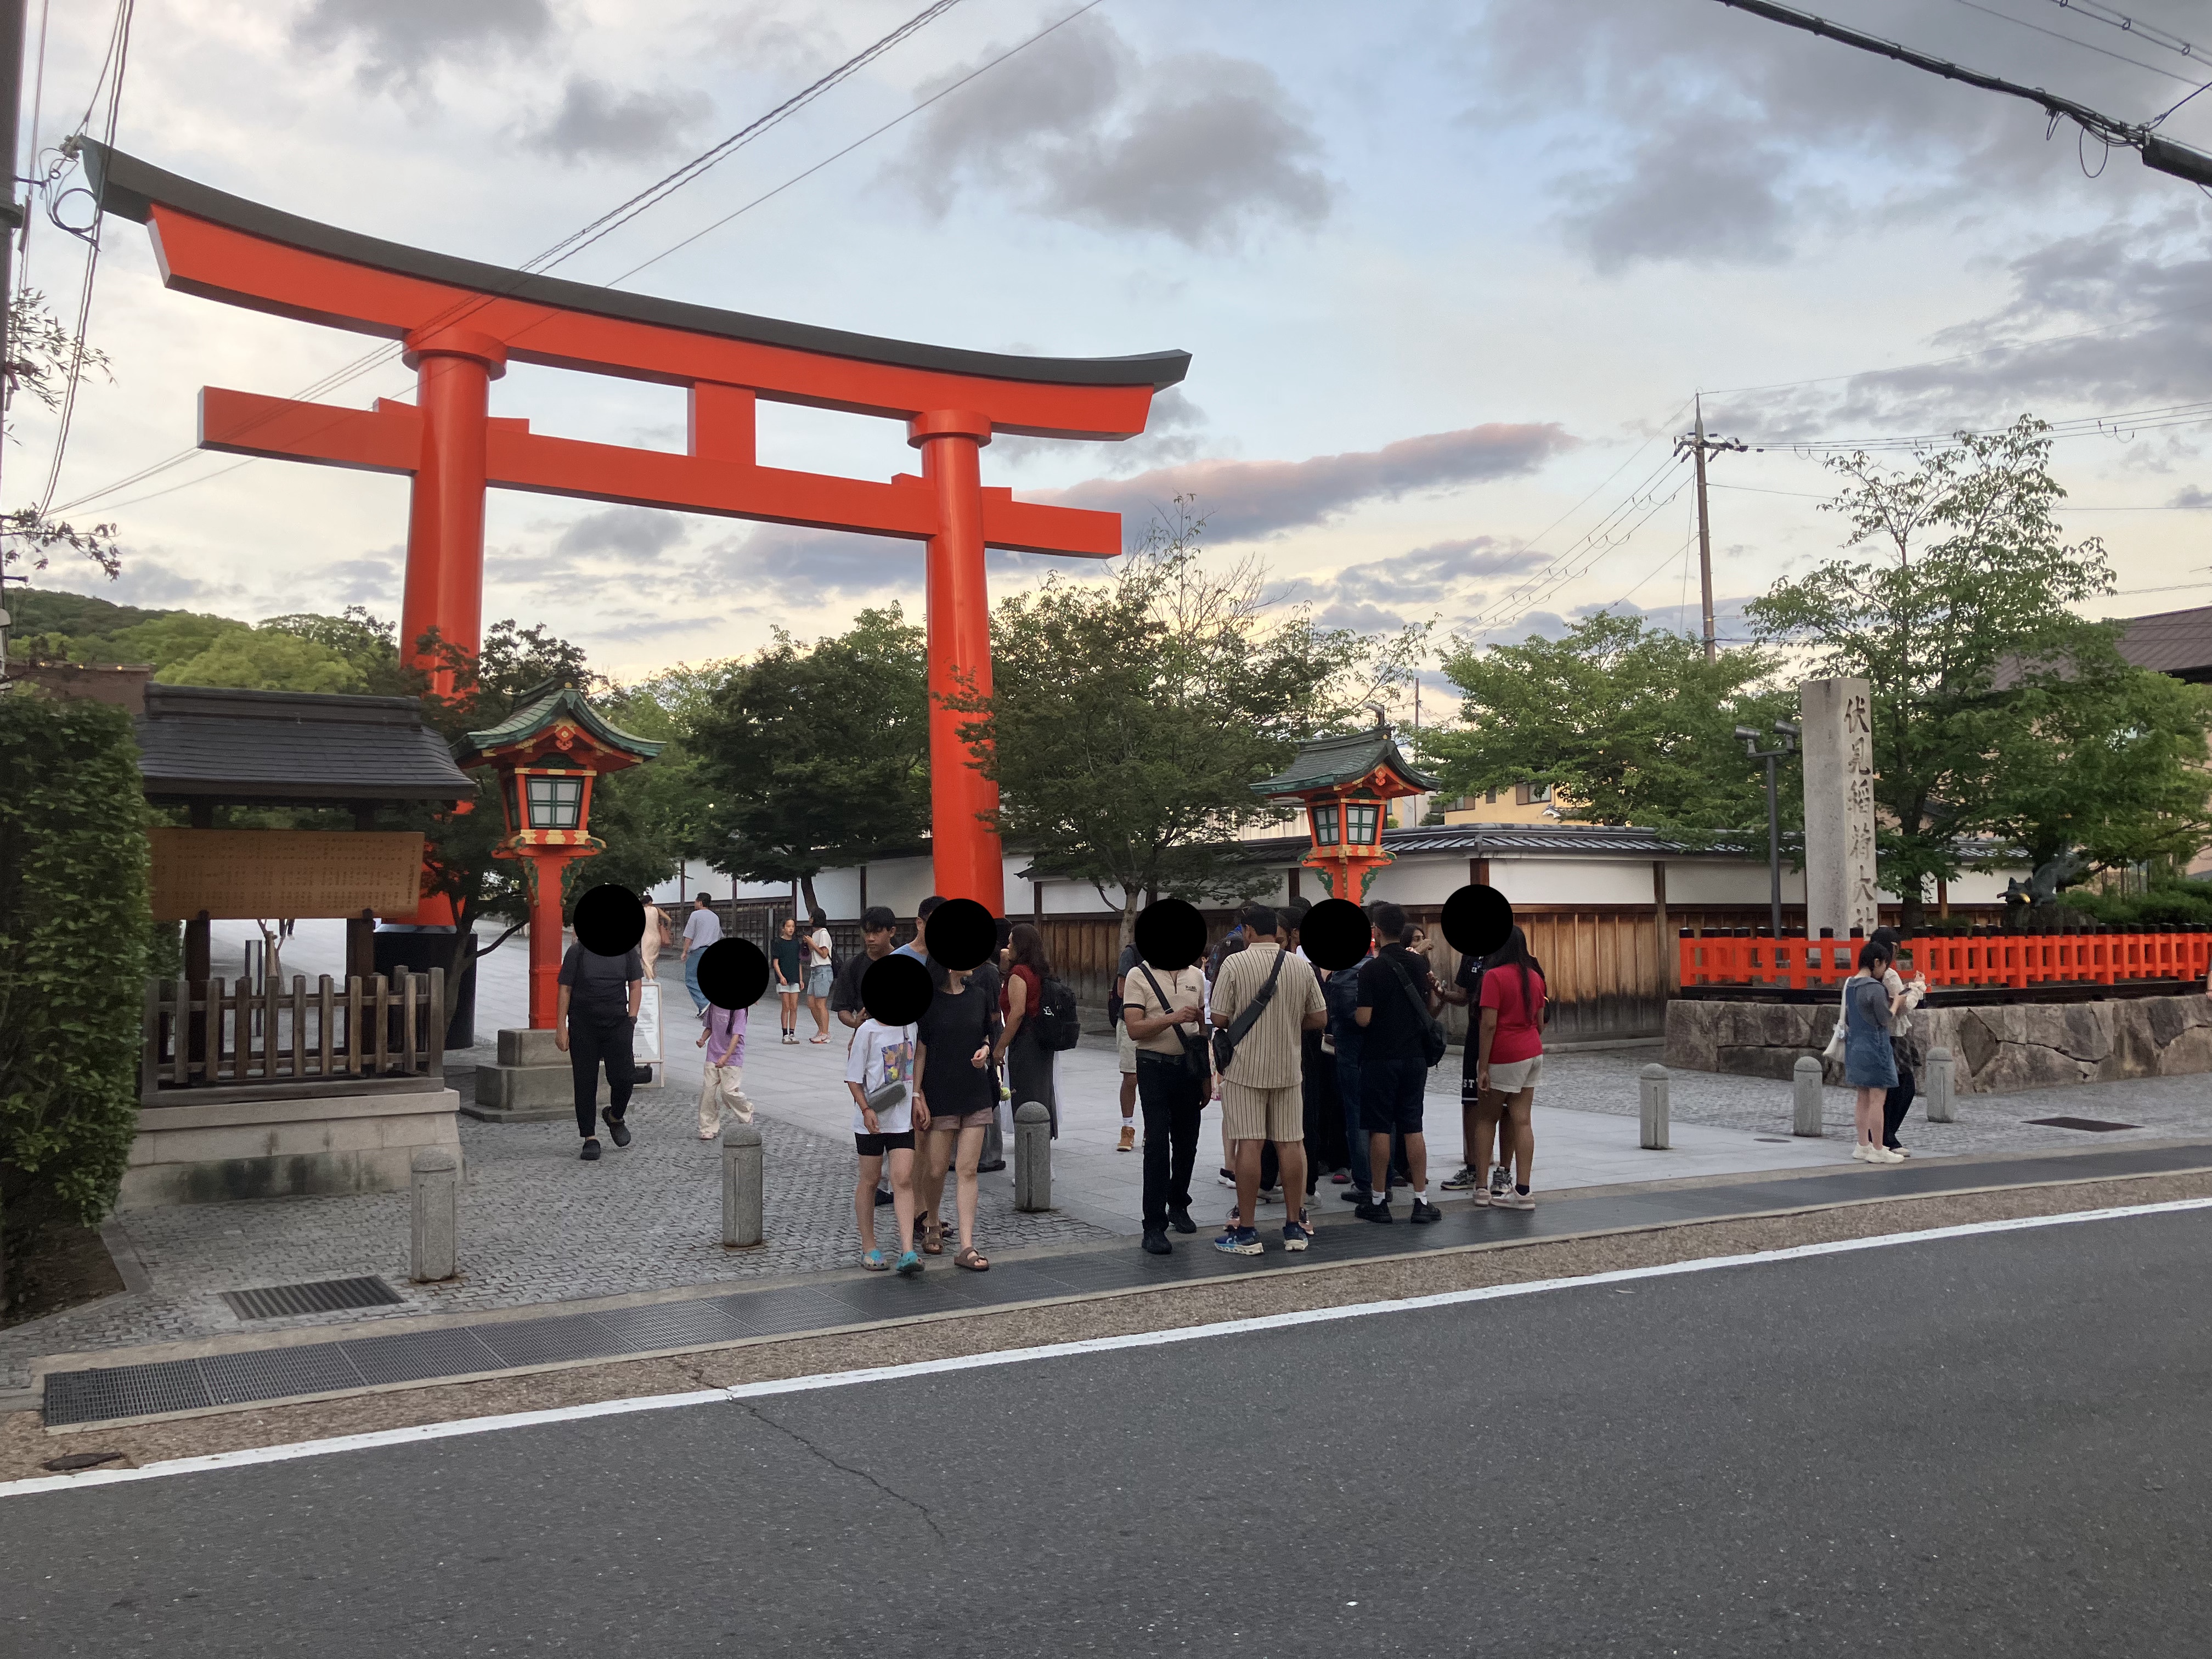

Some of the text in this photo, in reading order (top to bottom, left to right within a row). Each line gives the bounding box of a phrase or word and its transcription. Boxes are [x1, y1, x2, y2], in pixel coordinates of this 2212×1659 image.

[1843, 695, 1874, 937] 伏見稲荷大社
[1463, 1078, 1478, 1088] ST
